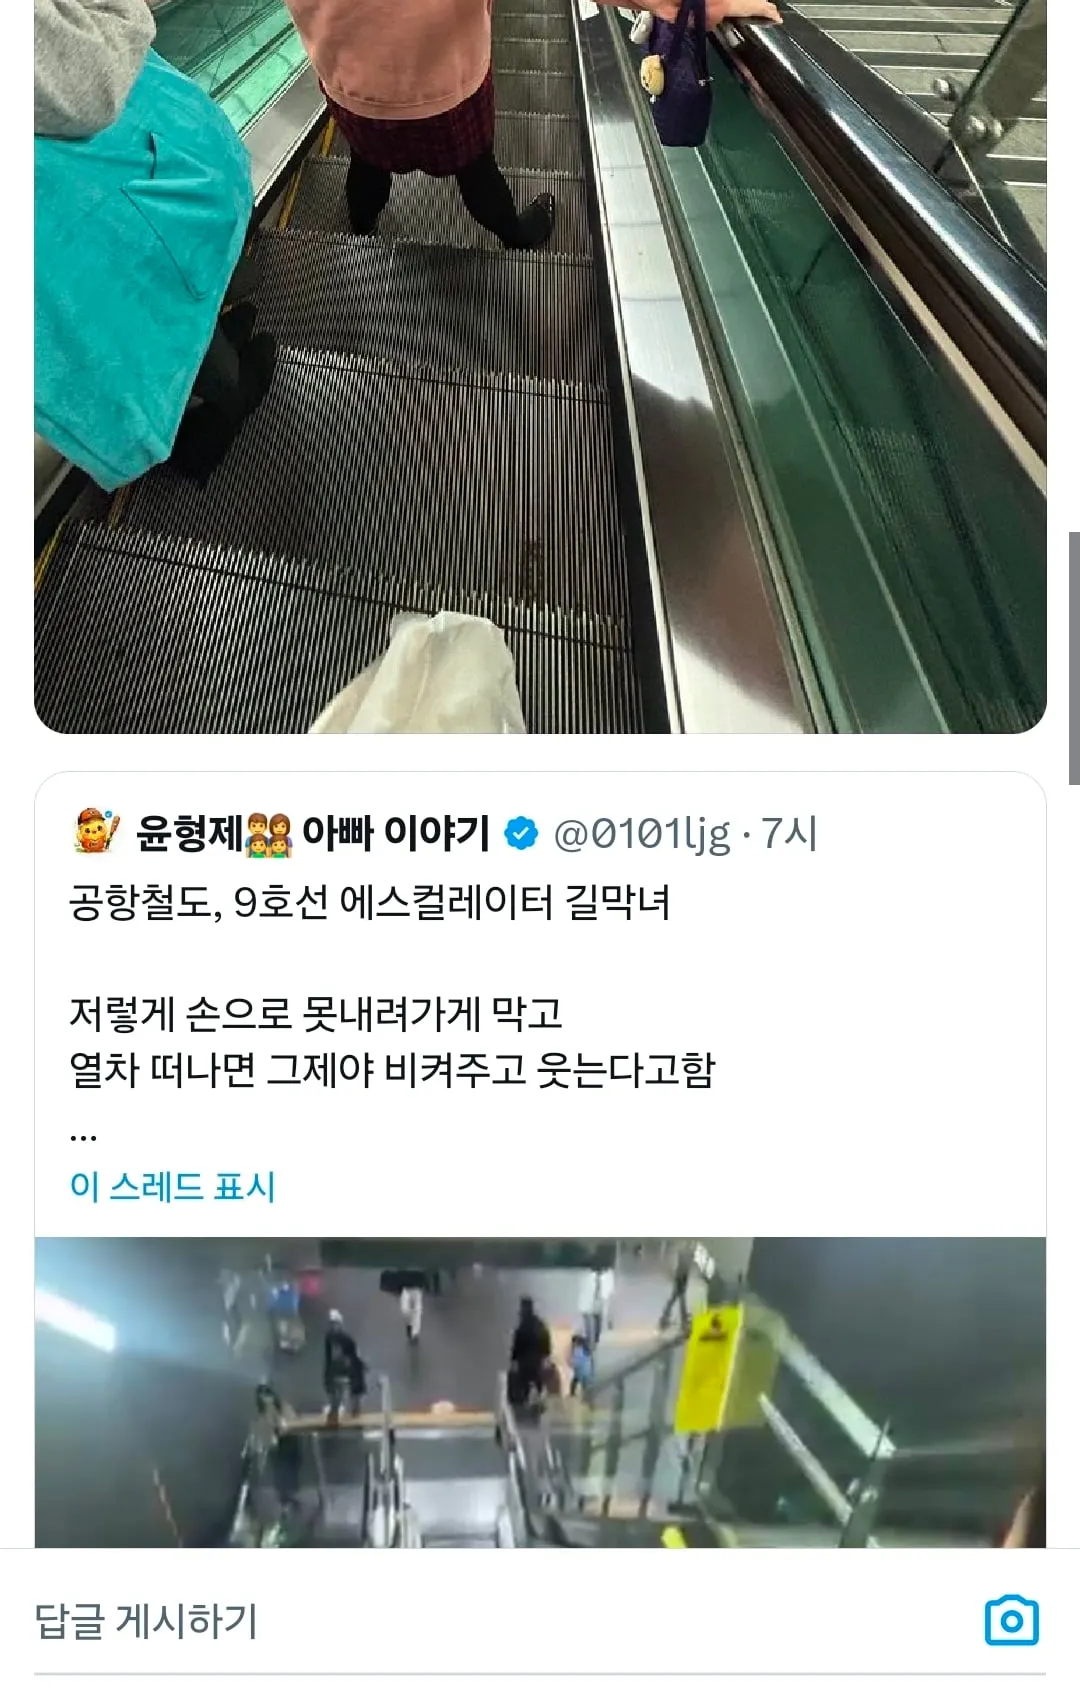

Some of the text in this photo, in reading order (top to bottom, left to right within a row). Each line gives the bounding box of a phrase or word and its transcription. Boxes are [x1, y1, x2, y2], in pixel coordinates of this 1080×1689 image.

[136, 814, 243, 853] 윤형제
[302, 814, 375, 853] 아빠
[384, 814, 489, 853] 이야기
[554, 815, 731, 857] @0101ljg
[762, 815, 816, 852] 7시
[68, 883, 669, 924] 공항철도, 9호선 에스컬레이터 길막녀
[69, 995, 563, 1034] 저렇게 손으로 못내려가게 막고
[70, 1051, 717, 1089] 열차 떠나면 그제야 비켜주고 웃는다고함
[70, 1170, 274, 1204] 이 스레드 표시
[36, 1603, 256, 1641] 답글 게시하기
